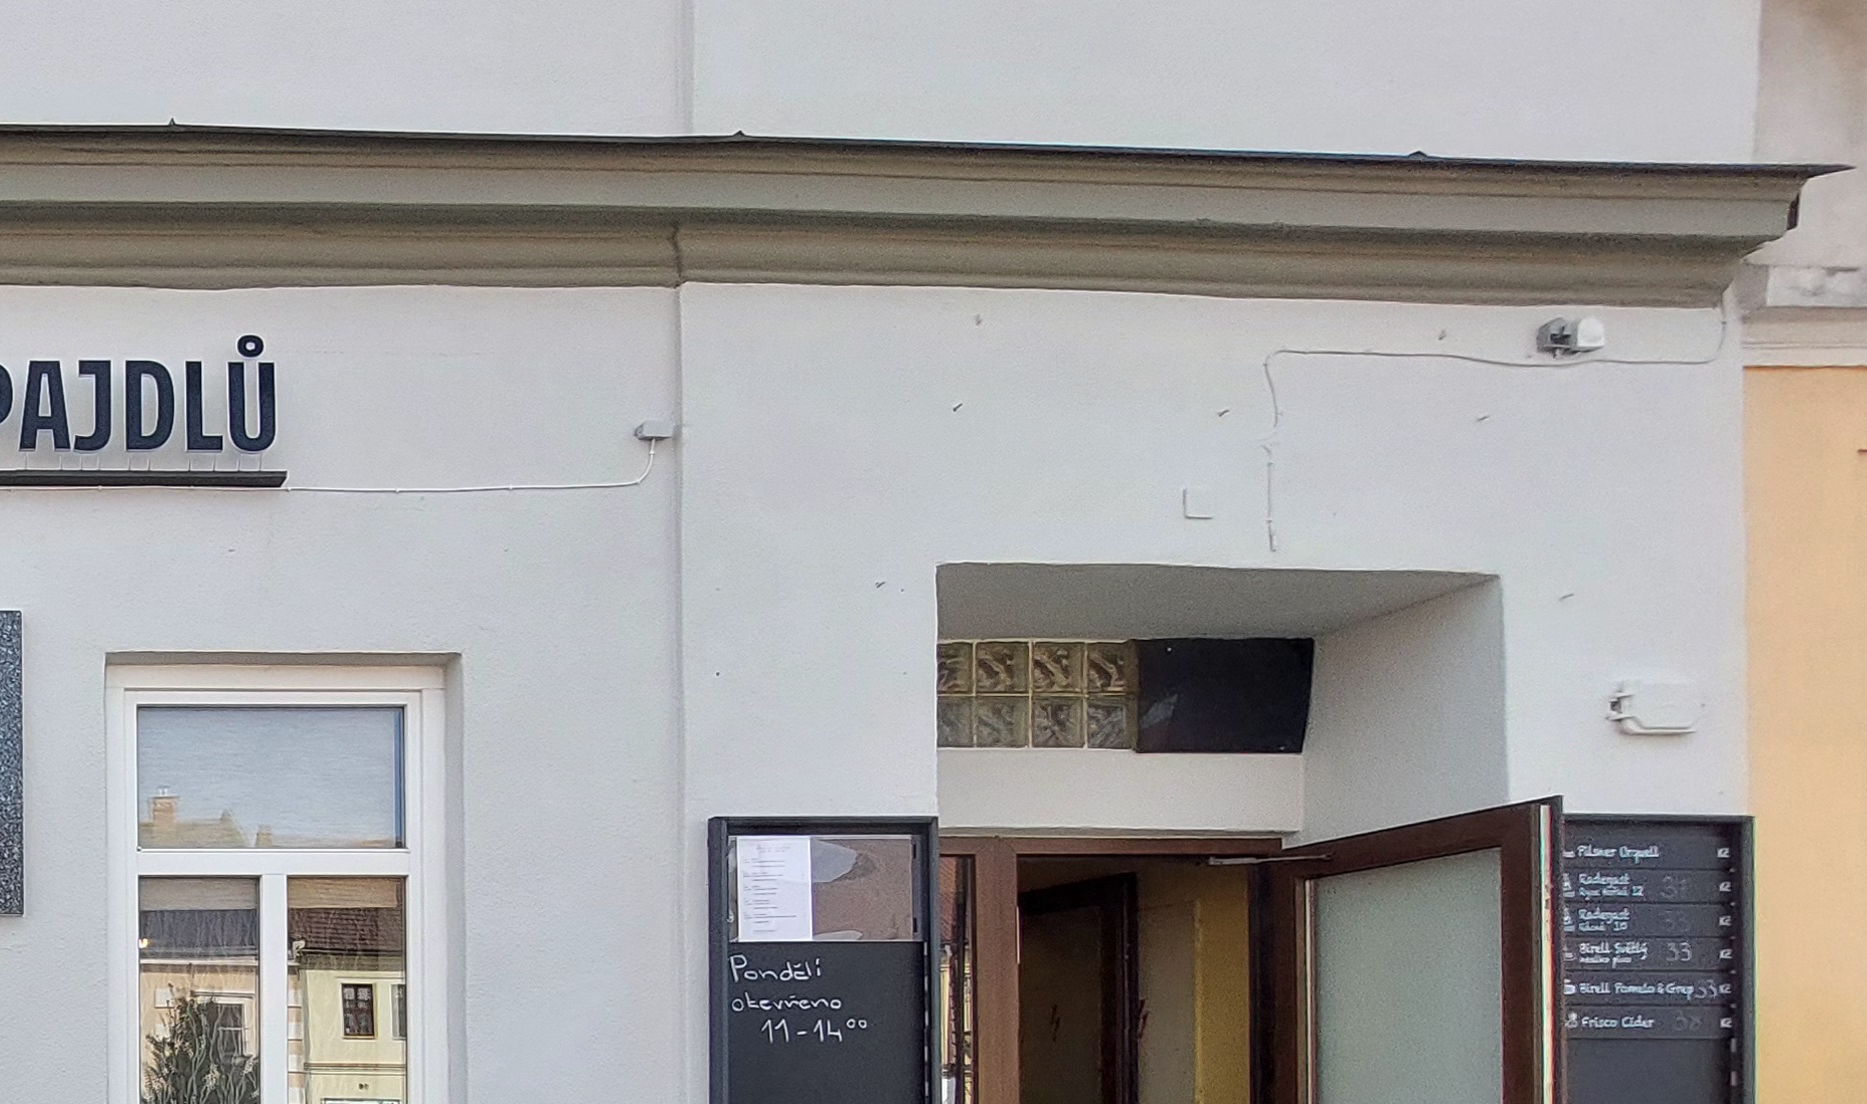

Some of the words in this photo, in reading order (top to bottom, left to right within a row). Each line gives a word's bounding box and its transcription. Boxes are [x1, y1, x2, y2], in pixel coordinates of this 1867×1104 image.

[729, 954, 822, 983] Pondělí
[1581, 1017, 1617, 1028] Frisco
[1621, 1015, 1655, 1028] Cider
